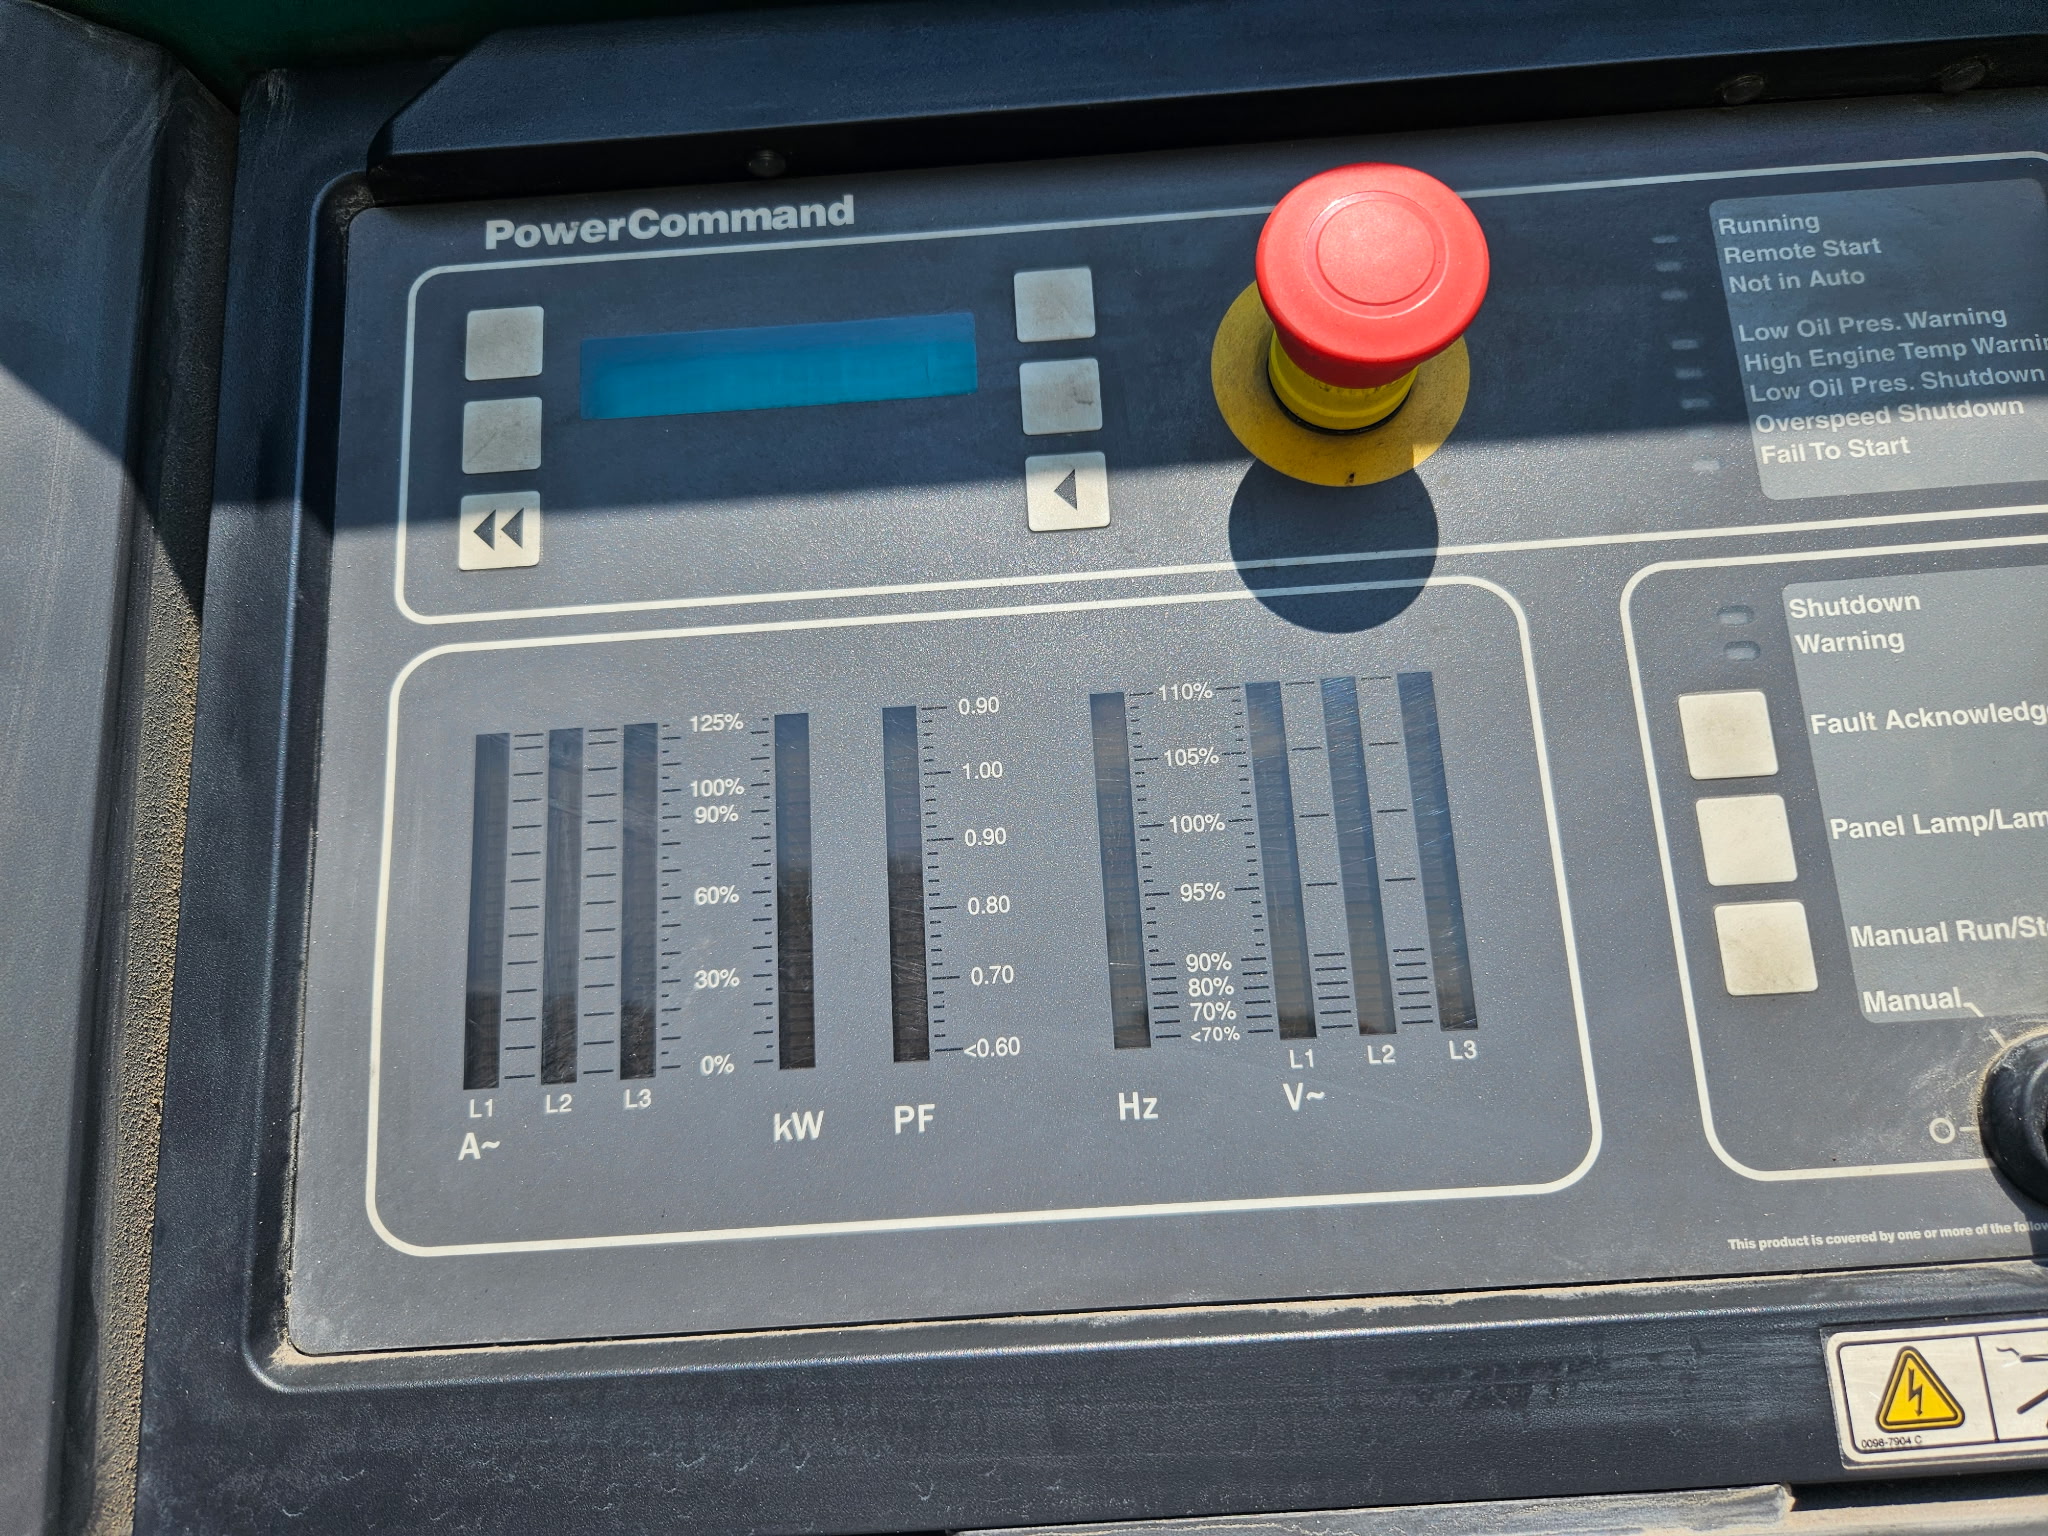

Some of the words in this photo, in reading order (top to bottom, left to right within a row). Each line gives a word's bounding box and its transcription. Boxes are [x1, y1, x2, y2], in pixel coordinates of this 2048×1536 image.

[485, 194, 855, 250] PowerCommand
[1718, 214, 1820, 235] Running
[1723, 241, 1816, 264] Remote
[1822, 237, 1882, 257] Start
[1729, 273, 1772, 293] Not
[1779, 271, 1801, 290] in
[1809, 269, 1865, 288] Auto
[1738, 323, 1789, 342] Low
[1796, 318, 1831, 338] Oil
[1838, 316, 1901, 335] Pres.
[1904, 308, 2007, 328] Warning
[1743, 351, 1802, 375] High
[1809, 345, 1895, 369] Engine
[1899, 340, 1968, 362] Temp
[1749, 383, 1801, 403] Low
[1809, 377, 1844, 399] Oil
[1851, 375, 1915, 396] Pres.
[1921, 367, 2045, 390] Shutdown
[1755, 406, 1891, 434] Overspeed
[1898, 399, 2024, 423] Shutdown
[1760, 443, 1806, 465] Fail
[1808, 441, 1841, 461] To
[1848, 436, 1911, 458] Start
[1789, 592, 1921, 619] Shutdown
[1795, 630, 1905, 655] Warning
[1158, 683, 1213, 701] 110%
[958, 696, 1000, 716] 0.90
[689, 713, 744, 733] 125%
[1810, 711, 1878, 736] Fault
[1886, 700, 2048, 732] Acknowledg
[1163, 749, 1219, 767] 105%
[962, 761, 1003, 781] 1.00
[690, 779, 745, 798] 100%
[694, 805, 739, 825] 90%
[1169, 814, 1226, 834] 100%
[964, 827, 1007, 847] 0.90
[1830, 814, 1905, 840] Panel
[695, 886, 740, 905] 60%
[1180, 883, 1226, 902] 95%
[967, 896, 1010, 915] 0.80
[1850, 922, 1949, 949] Manual
[1956, 915, 2048, 942] Run/St
[1185, 953, 1232, 972] 90%
[695, 969, 740, 989] 30%
[971, 966, 1014, 986] 0.70
[1188, 978, 1234, 997] 80%
[1863, 987, 1962, 1014] Manual
[1190, 1003, 1237, 1022] 70%
[1190, 1027, 1240, 1043] <70%
[964, 1037, 1021, 1058] <0.60
[1289, 1049, 1315, 1070] L1
[1367, 1045, 1396, 1065] L2
[1448, 1040, 1478, 1060] L3
[701, 1056, 735, 1076] 0%
[469, 1099, 494, 1119] L1
[545, 1094, 573, 1115] L2
[624, 1089, 652, 1111] L3
[1119, 1092, 1158, 1121] Hz
[773, 1111, 824, 1143] kW
[893, 1104, 936, 1134] PF
[1727, 1238, 1756, 1250] This
[1758, 1235, 1809, 1251] product
[1811, 1234, 1823, 1246] is
[1826, 1231, 1877, 1245] covered
[1878, 1230, 1895, 1243] by
[1897, 1229, 1921, 1240] one
[1924, 1228, 1937, 1239] or
[1940, 1226, 1974, 1238] more
[1975, 1223, 1989, 1235] of
[1990, 1222, 2012, 1235] the
[1861, 1436, 1912, 1448] 0098-7904
